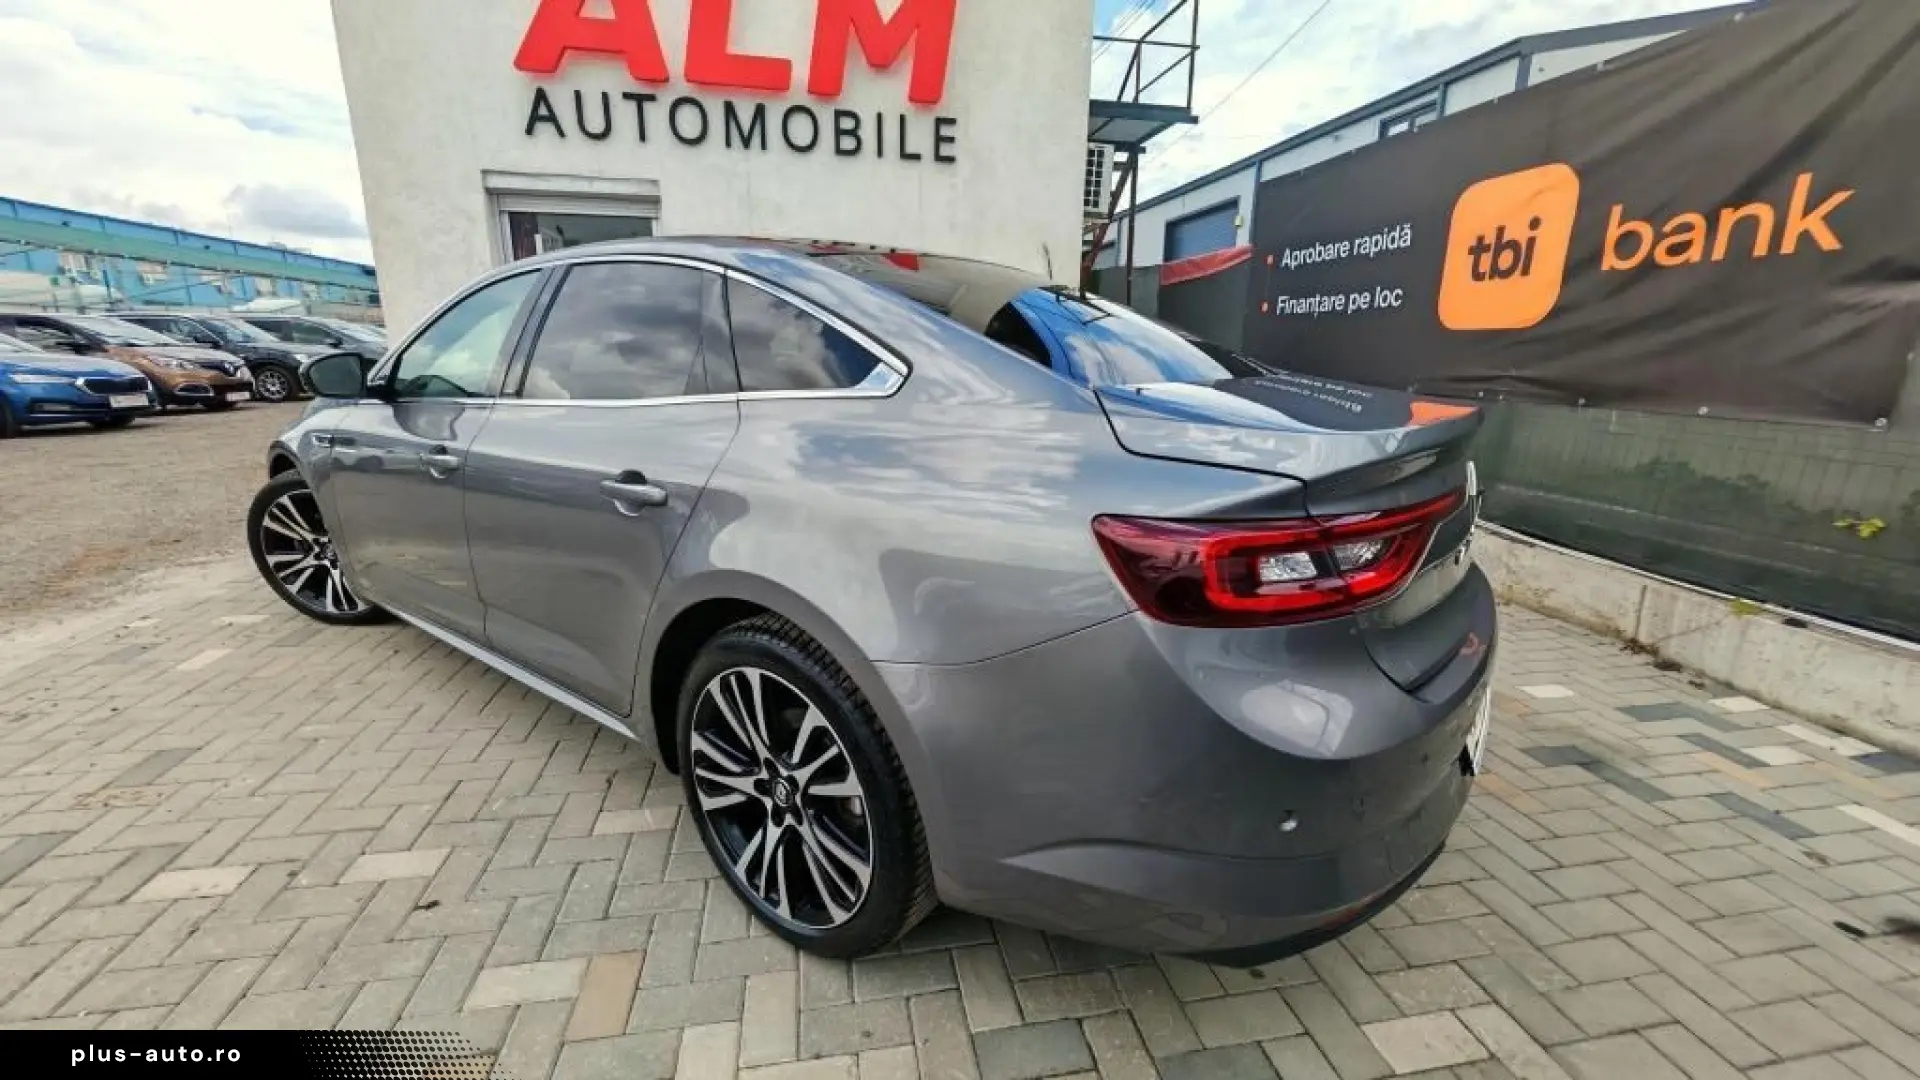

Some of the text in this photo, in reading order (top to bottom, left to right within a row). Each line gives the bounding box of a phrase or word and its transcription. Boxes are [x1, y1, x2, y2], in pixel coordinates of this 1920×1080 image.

[513, 0, 957, 104] ALM
[524, 87, 957, 163] AUTOMOBILE
[1281, 223, 1412, 270] Aprobare rapidă
[1467, 172, 1856, 282] tbi bank
[1276, 286, 1403, 319] Finanțare pe loc
